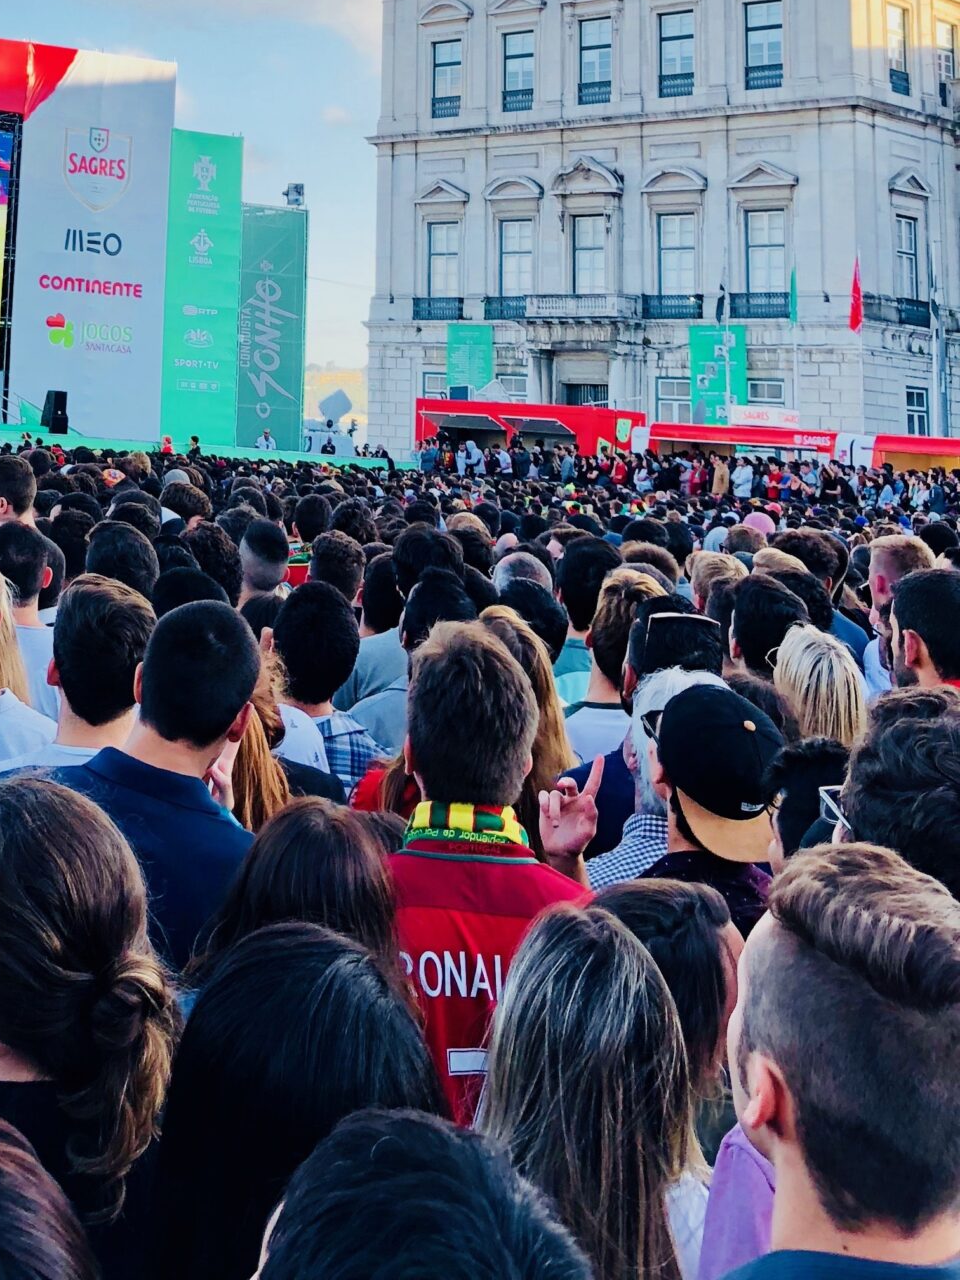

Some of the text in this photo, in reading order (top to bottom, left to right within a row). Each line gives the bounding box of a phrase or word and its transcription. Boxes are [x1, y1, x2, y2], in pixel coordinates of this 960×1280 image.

[68, 152, 126, 180] SAGRES
[64, 228, 122, 256] MEO
[39, 274, 143, 299] CONTINENTE
[80, 321, 133, 344] JOGOS
[240, 306, 252, 368] CONQUISTA
[802, 434, 831, 447] SAGRES
